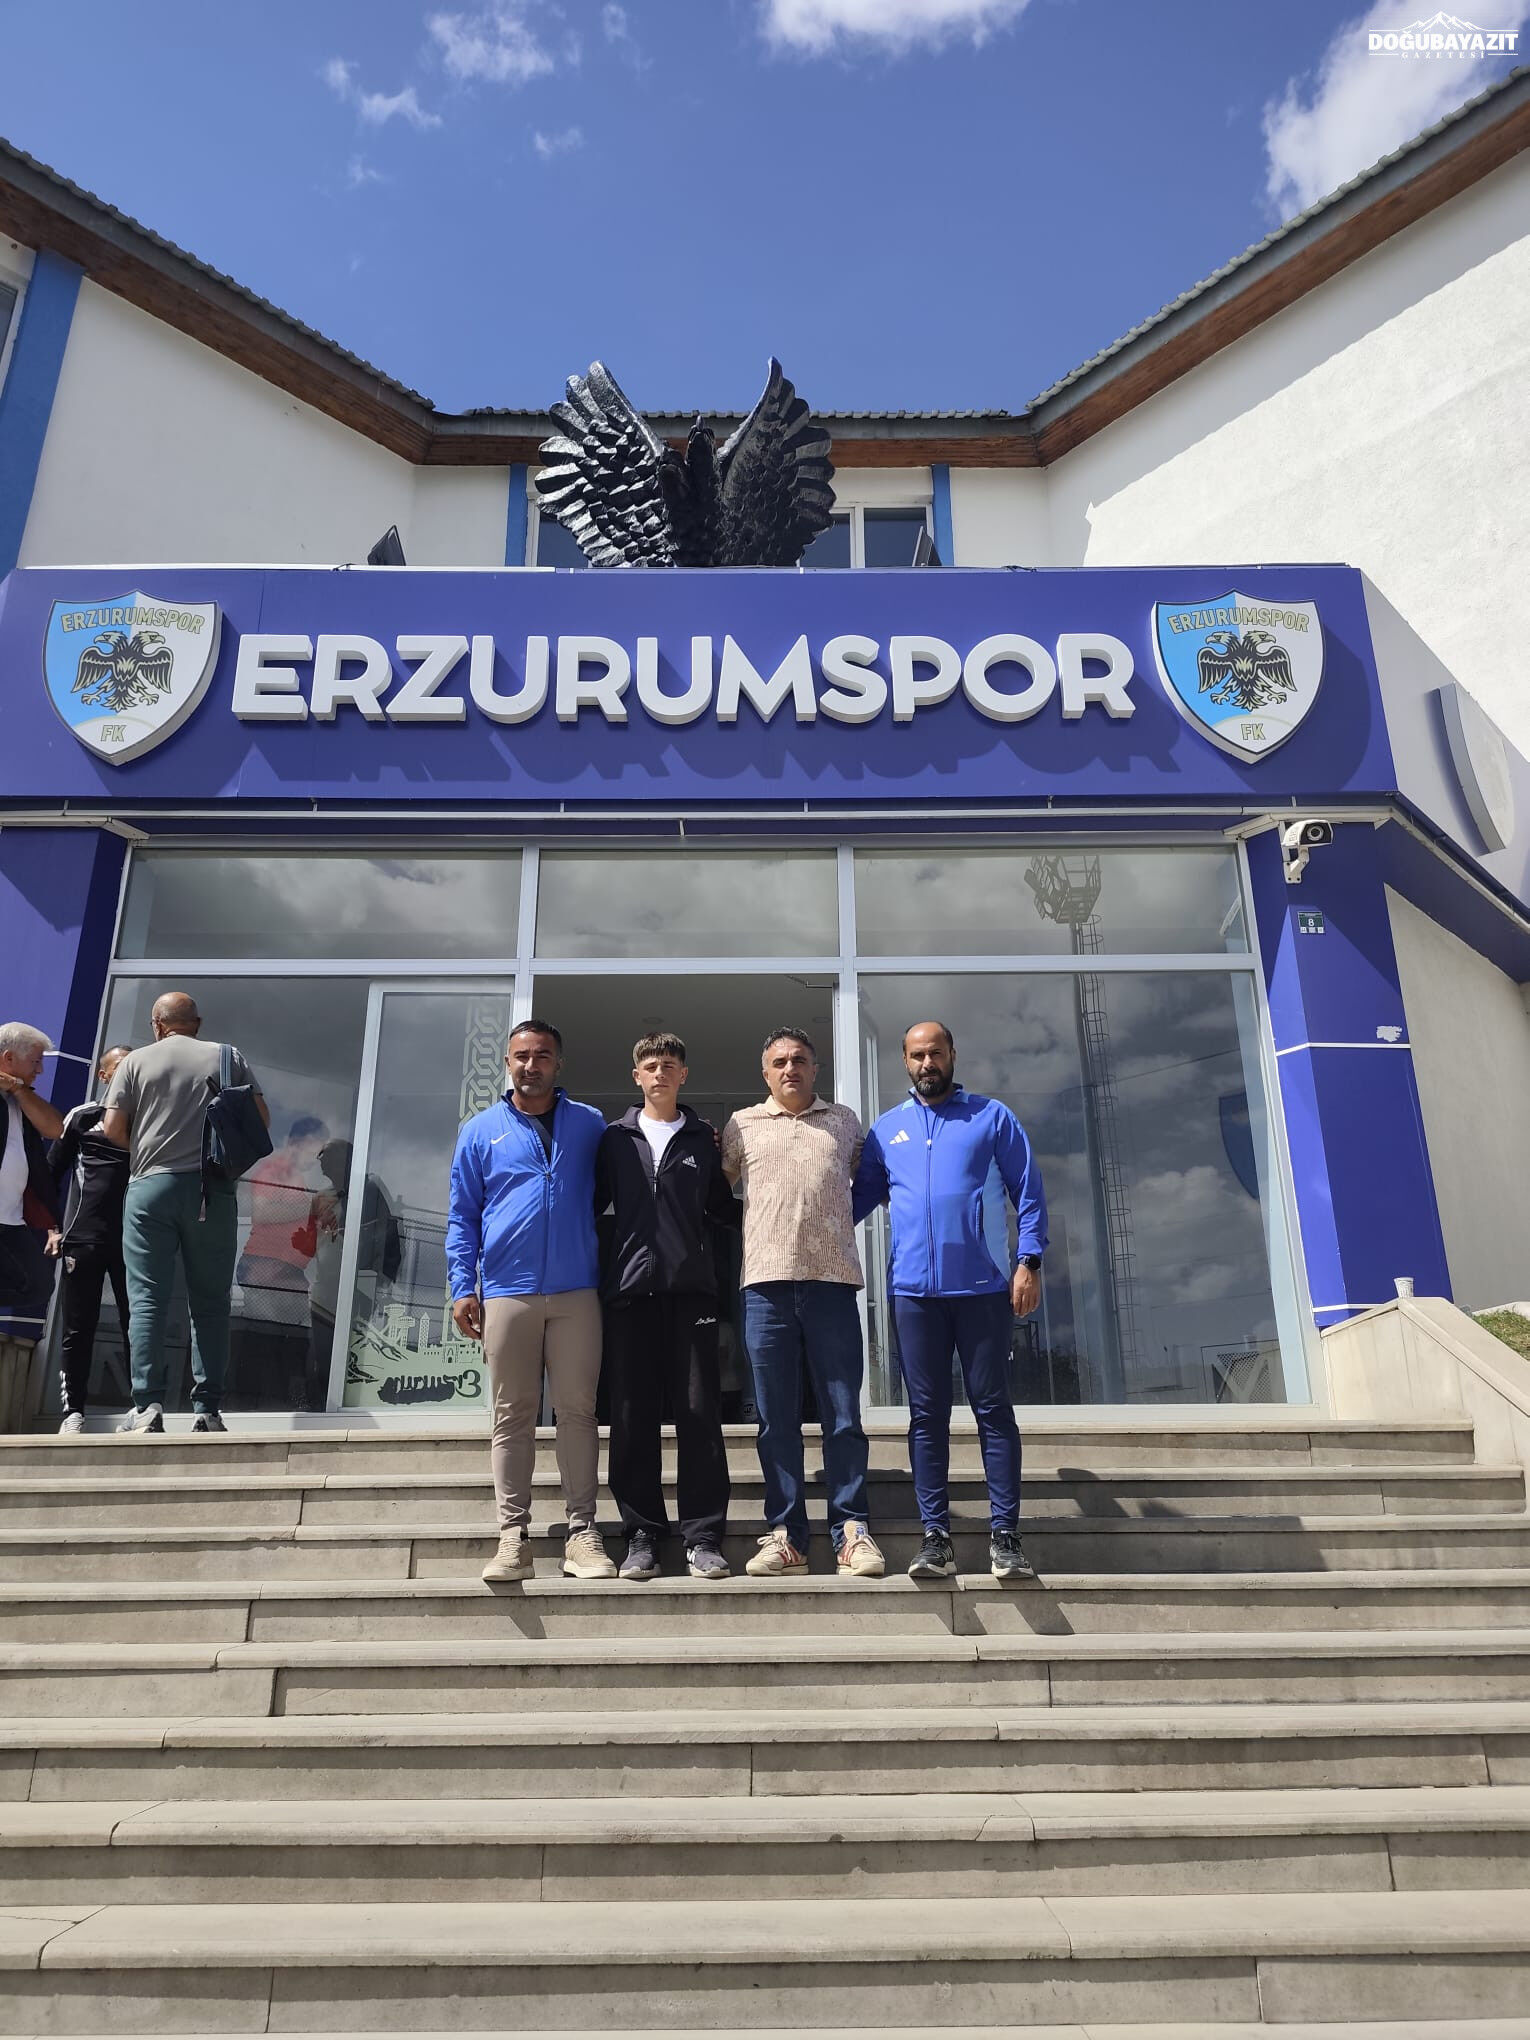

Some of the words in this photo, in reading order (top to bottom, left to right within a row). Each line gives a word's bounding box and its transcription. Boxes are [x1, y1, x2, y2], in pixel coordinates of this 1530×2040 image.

[60, 607, 206, 635] ERZURUMSPOR
[1167, 606, 1311, 635] ERZURUMSPOR
[231, 632, 1136, 726] ERZURUMSPOR
[100, 724, 127, 742] FK
[1240, 723, 1266, 741] FK
[1308, 918, 1315, 927] 8
